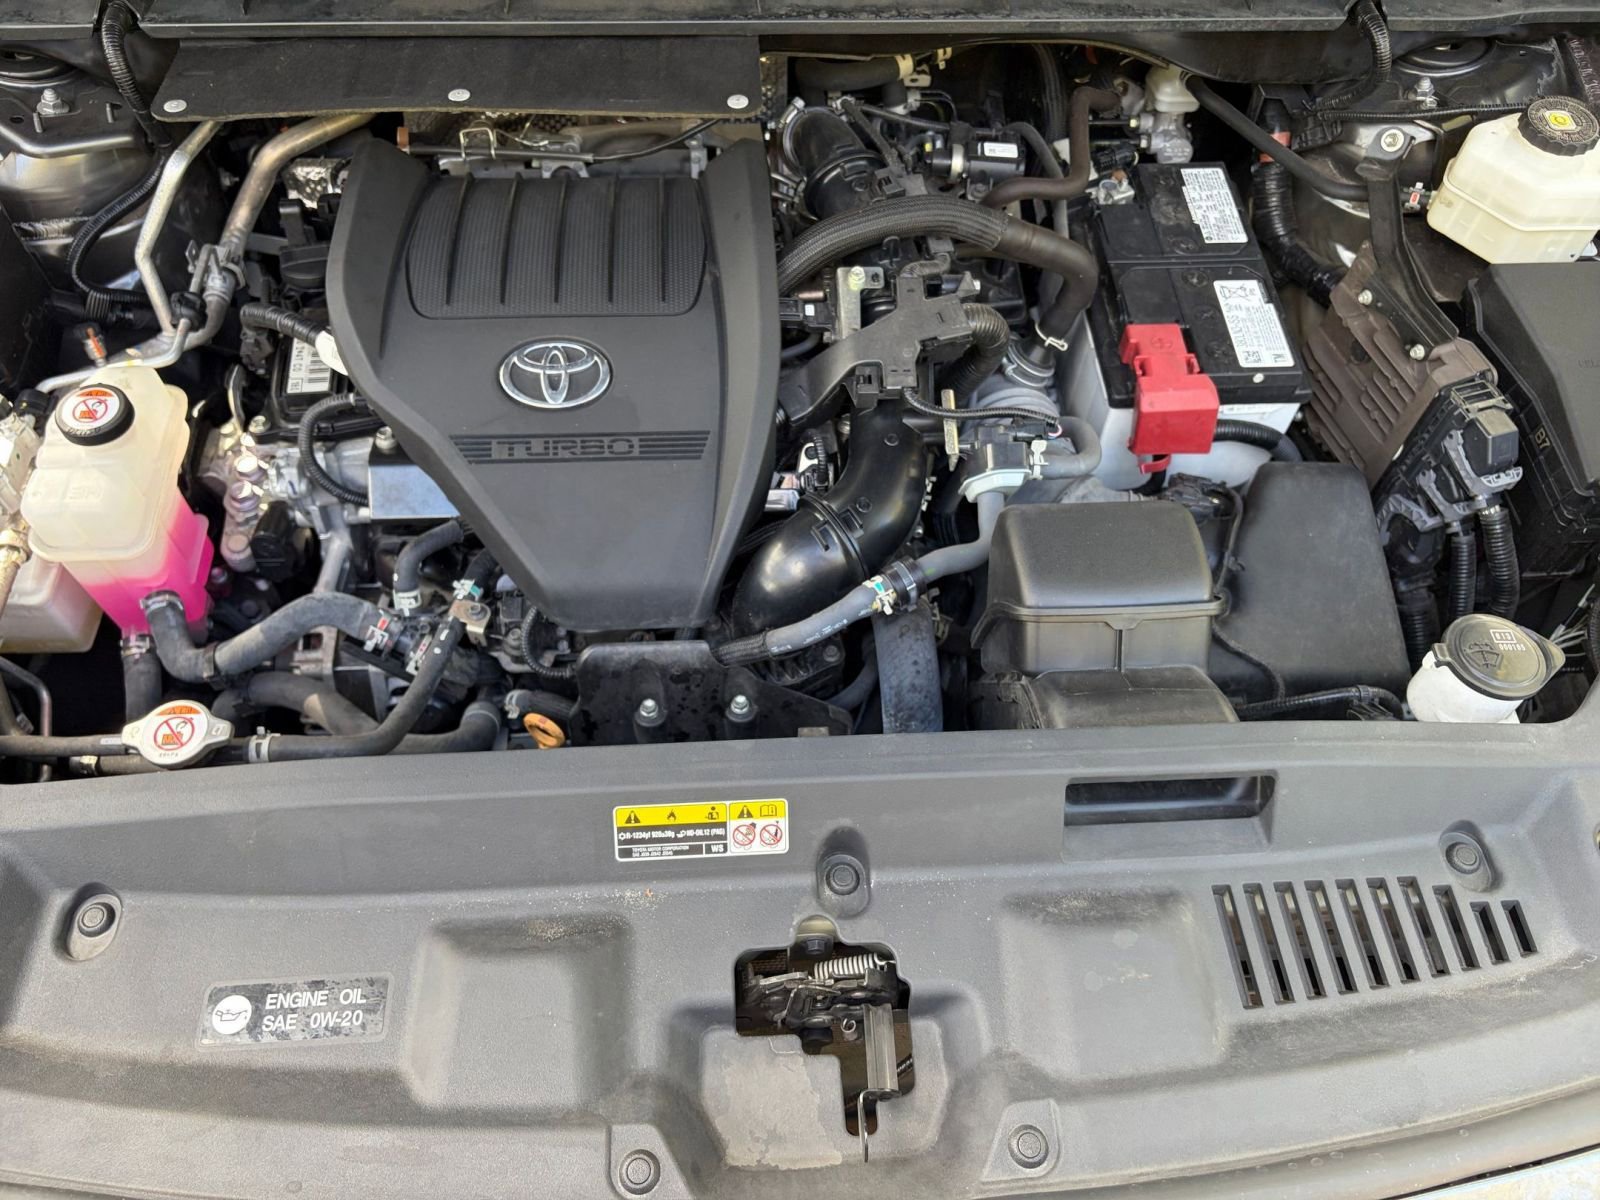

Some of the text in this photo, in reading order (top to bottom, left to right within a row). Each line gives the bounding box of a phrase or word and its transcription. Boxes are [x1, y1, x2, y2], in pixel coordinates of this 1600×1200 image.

[496, 438, 635, 457] TURBO
[711, 844, 724, 853] WS
[265, 988, 367, 1010] ENGINE OIL
[262, 1010, 364, 1032] SAE 0W-20
